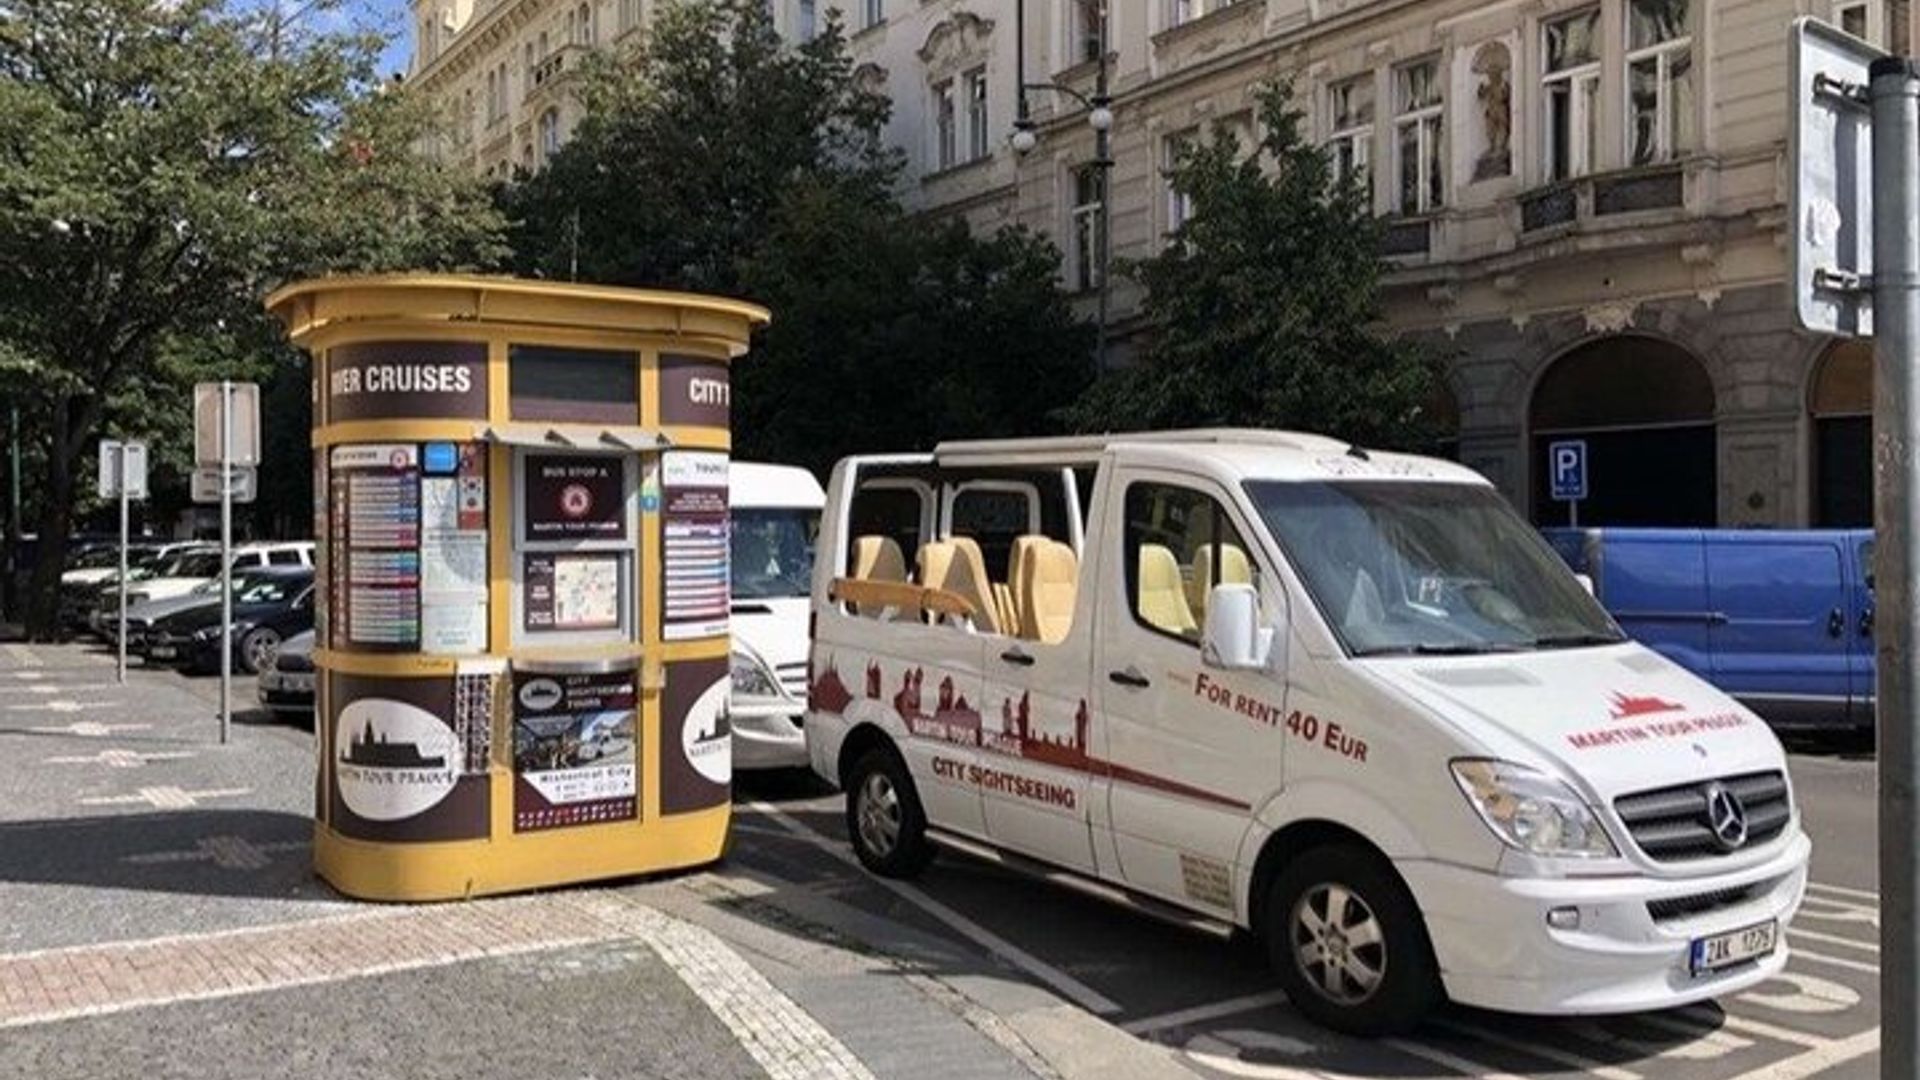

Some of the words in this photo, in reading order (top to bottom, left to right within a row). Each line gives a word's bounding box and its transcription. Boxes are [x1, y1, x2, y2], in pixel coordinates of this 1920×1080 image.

[365, 363, 471, 392] CRUISES
[690, 377, 722, 404] CITY
[1557, 449, 1578, 481] P
[1235, 694, 1282, 728] RENT
[1287, 710, 1319, 741] 40
[1567, 728, 1649, 749] MARTIN
[1648, 719, 1693, 738] TOUR
[932, 756, 966, 782] CITY
[968, 764, 1076, 809] SIGHTSEEING
